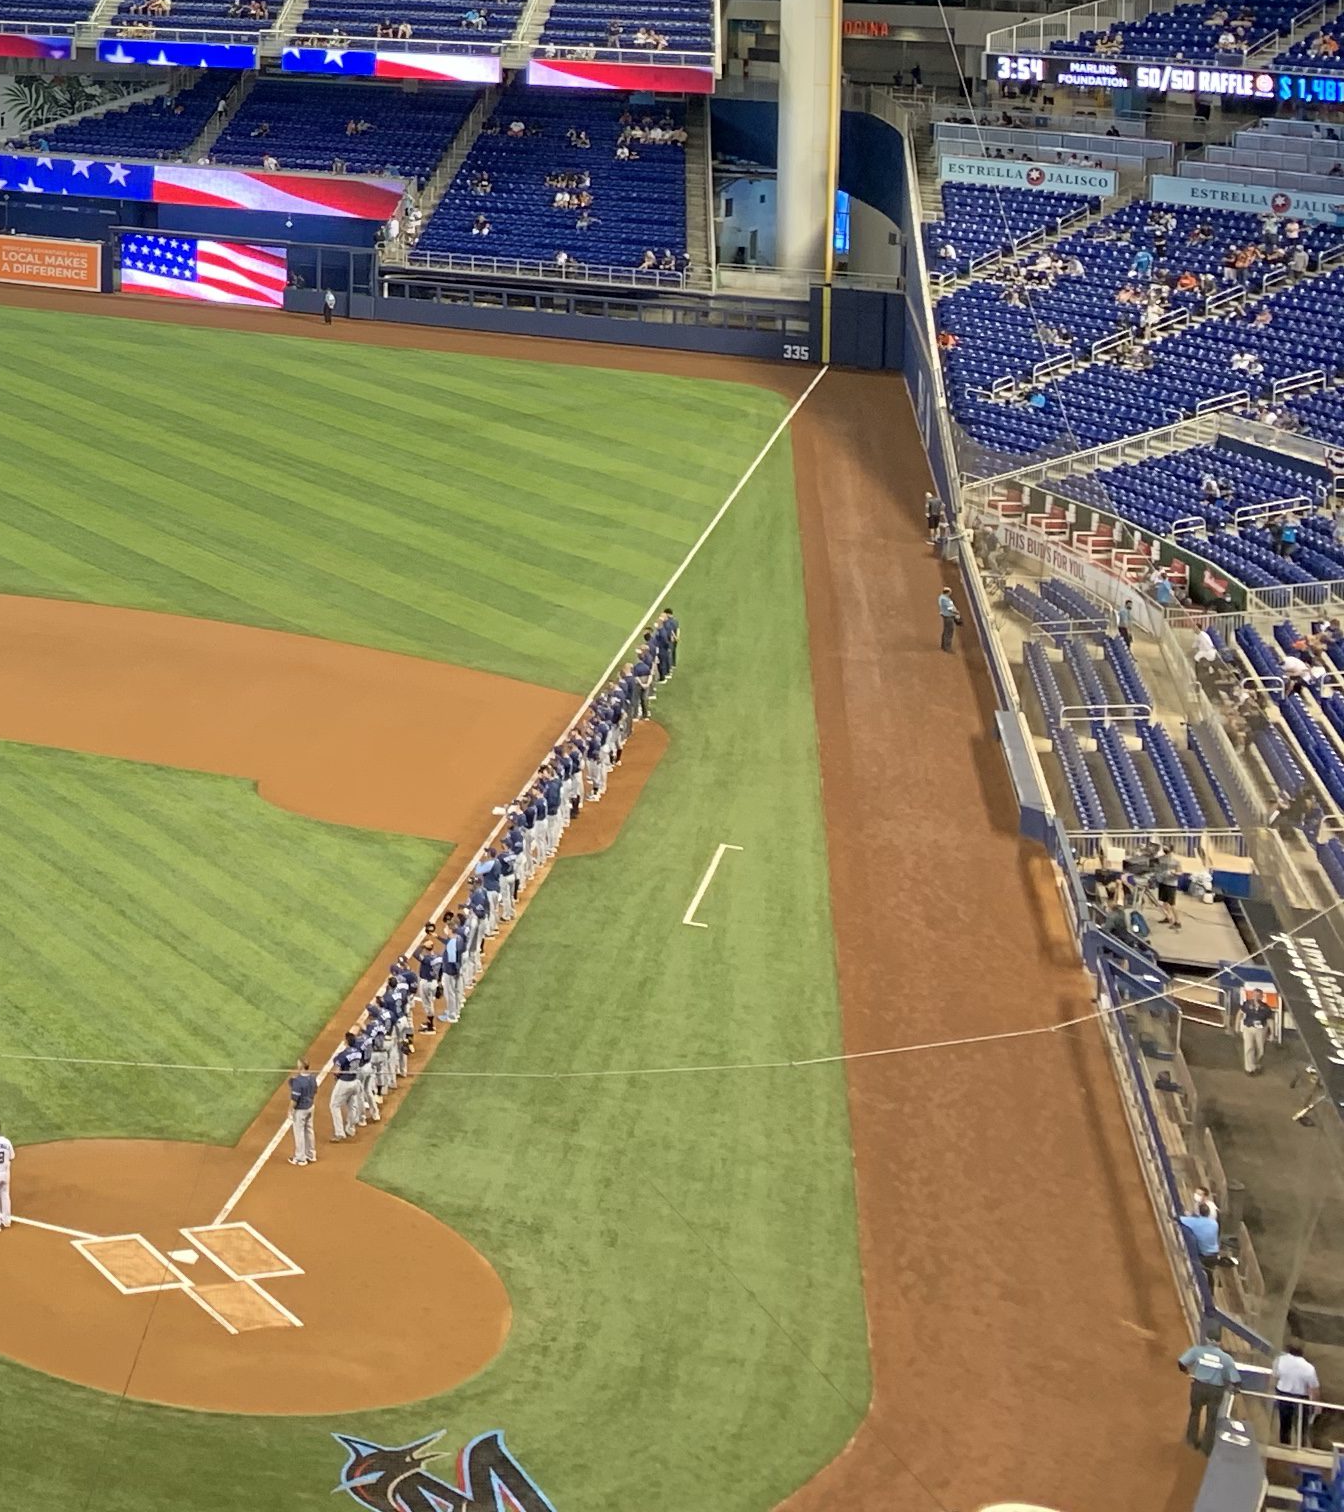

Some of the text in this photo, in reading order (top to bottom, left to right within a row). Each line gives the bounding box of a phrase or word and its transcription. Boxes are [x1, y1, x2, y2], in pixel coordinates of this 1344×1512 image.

[997, 56, 1044, 81] 3:54
[1069, 62, 1117, 75] MARLINS
[1058, 74, 1128, 88] FOUNDATION
[1137, 66, 1254, 96] 50/50 RAFFLE
[948, 163, 1109, 189] ESTRELLA JALISCO
[1191, 187, 1336, 214] ESTRELLA JALIS
[2, 251, 88, 269] LOCAL MAKES
[1, 264, 87, 280] A DIFFERENCE
[783, 344, 810, 360] 335
[1004, 527, 1025, 551] THIS
[1053, 549, 1069, 573] FOR
